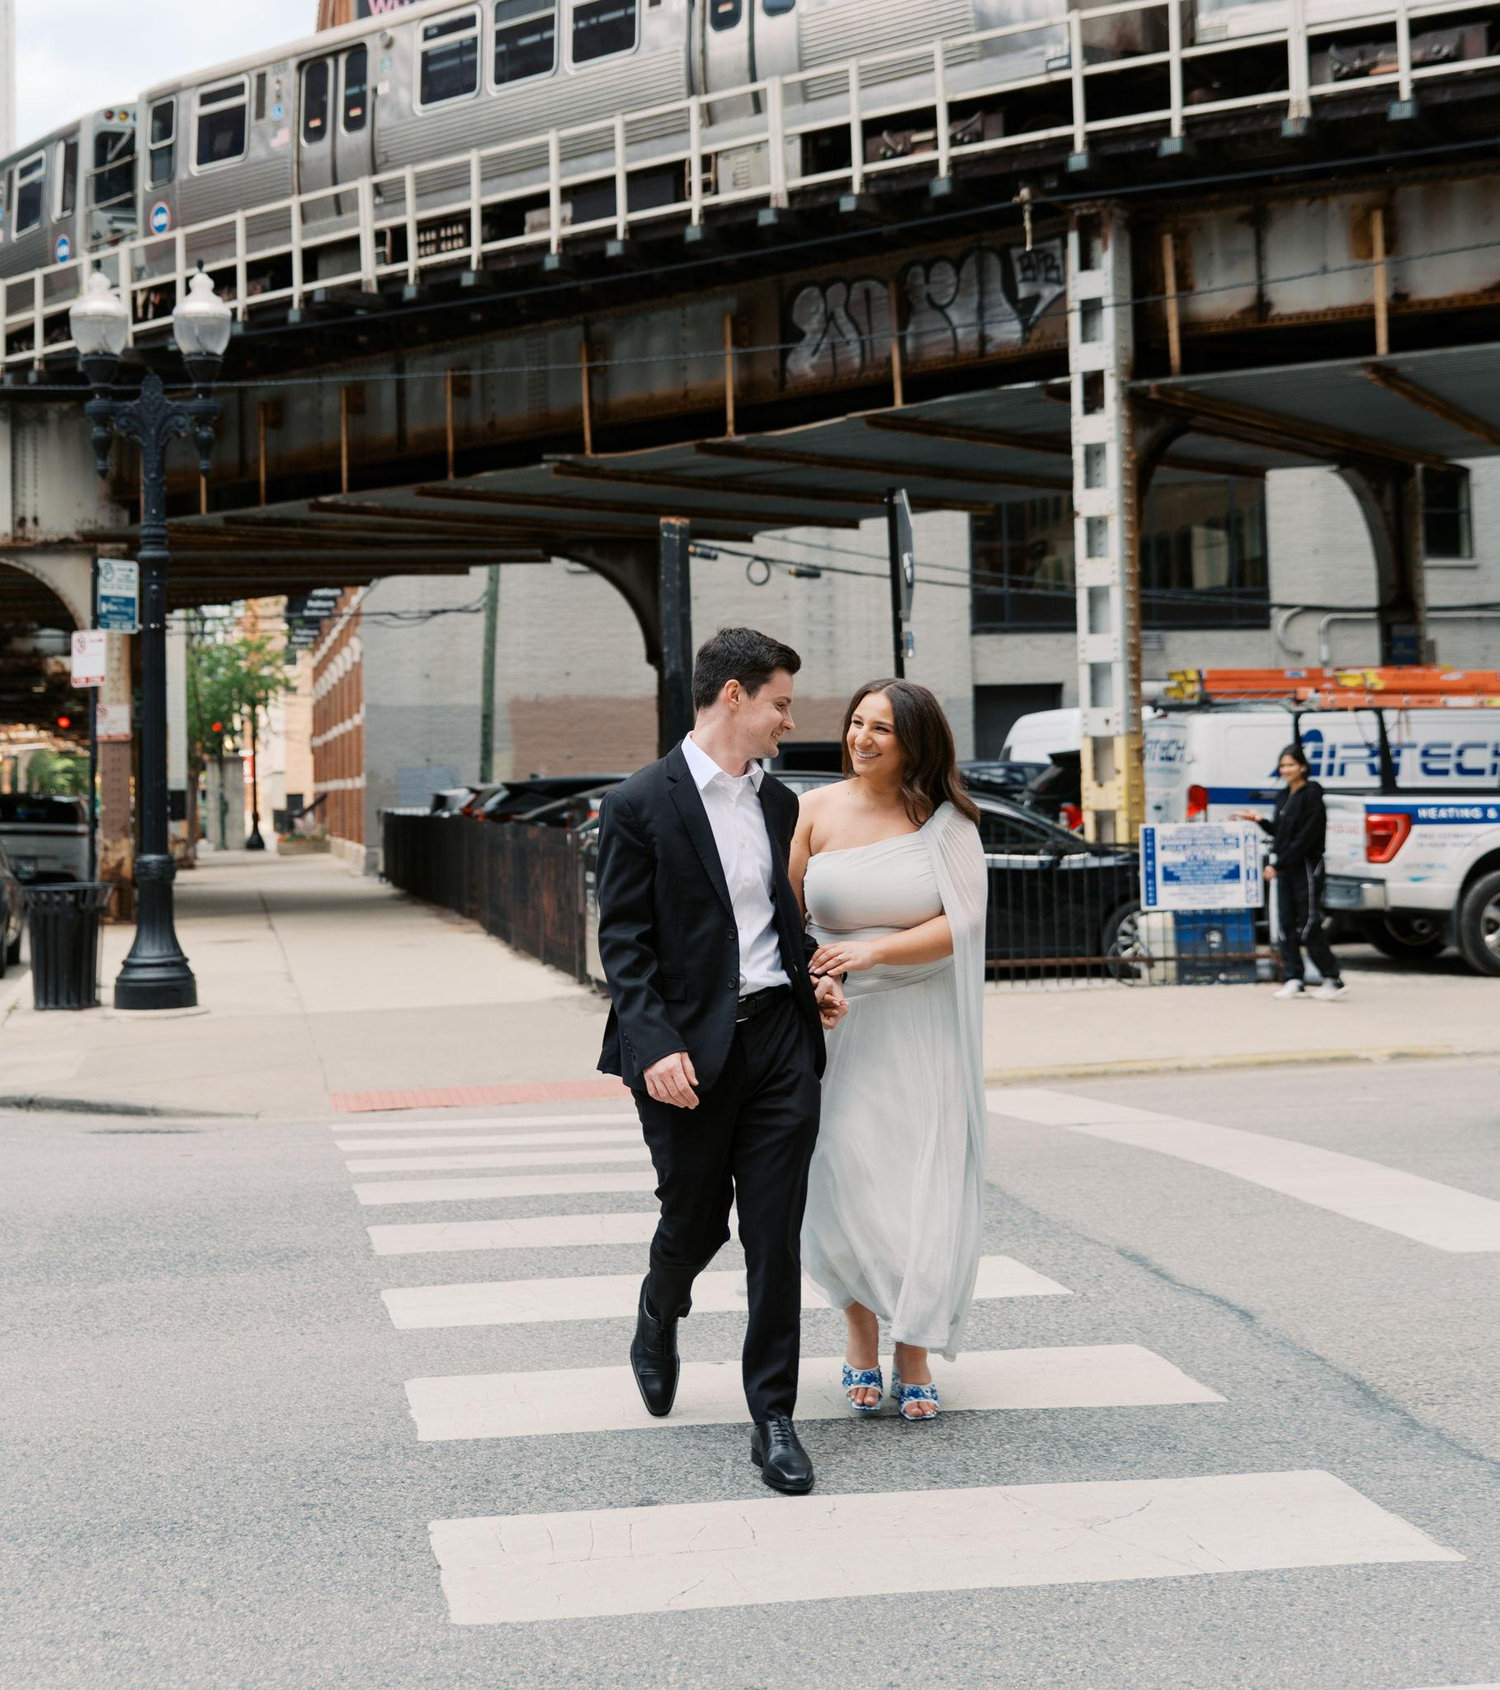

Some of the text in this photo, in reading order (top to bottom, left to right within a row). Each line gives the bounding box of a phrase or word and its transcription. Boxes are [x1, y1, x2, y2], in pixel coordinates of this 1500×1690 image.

[1271, 729, 1500, 777] AIRTEC
[1418, 807, 1498, 820] HEATING &
